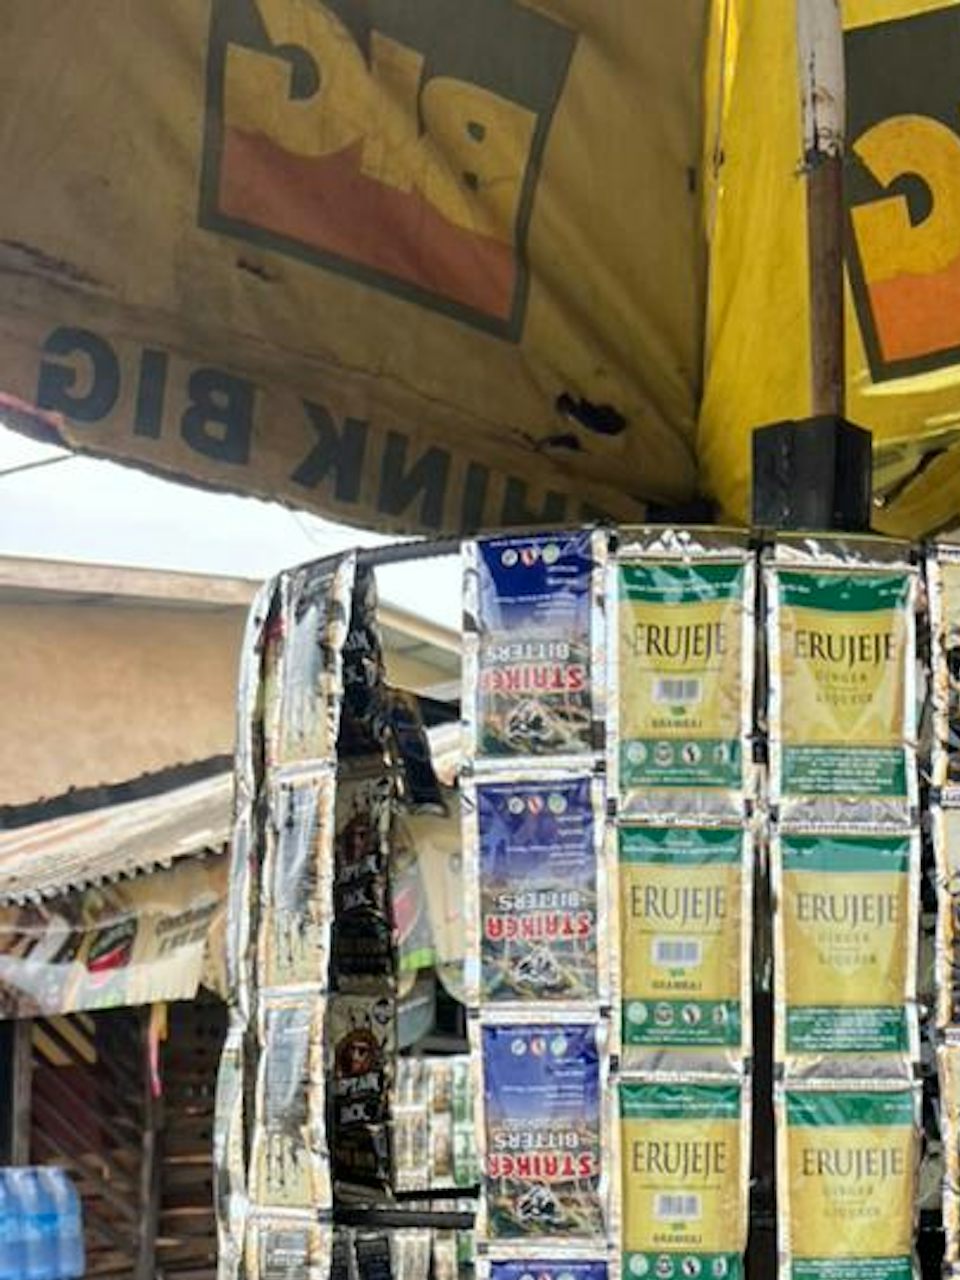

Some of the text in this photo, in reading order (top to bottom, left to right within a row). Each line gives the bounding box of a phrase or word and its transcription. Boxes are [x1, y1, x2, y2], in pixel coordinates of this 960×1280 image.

[631, 884, 728, 925] ERUJEJE
[796, 892, 899, 929] ERUJEJE
[486, 913, 592, 941] STRIKER
[494, 1131, 579, 1150] BITTERS
[632, 1140, 727, 1178] ERUJEJE
[487, 1152, 593, 1179] STRIKER
[802, 1147, 905, 1184] ERUJEJE
